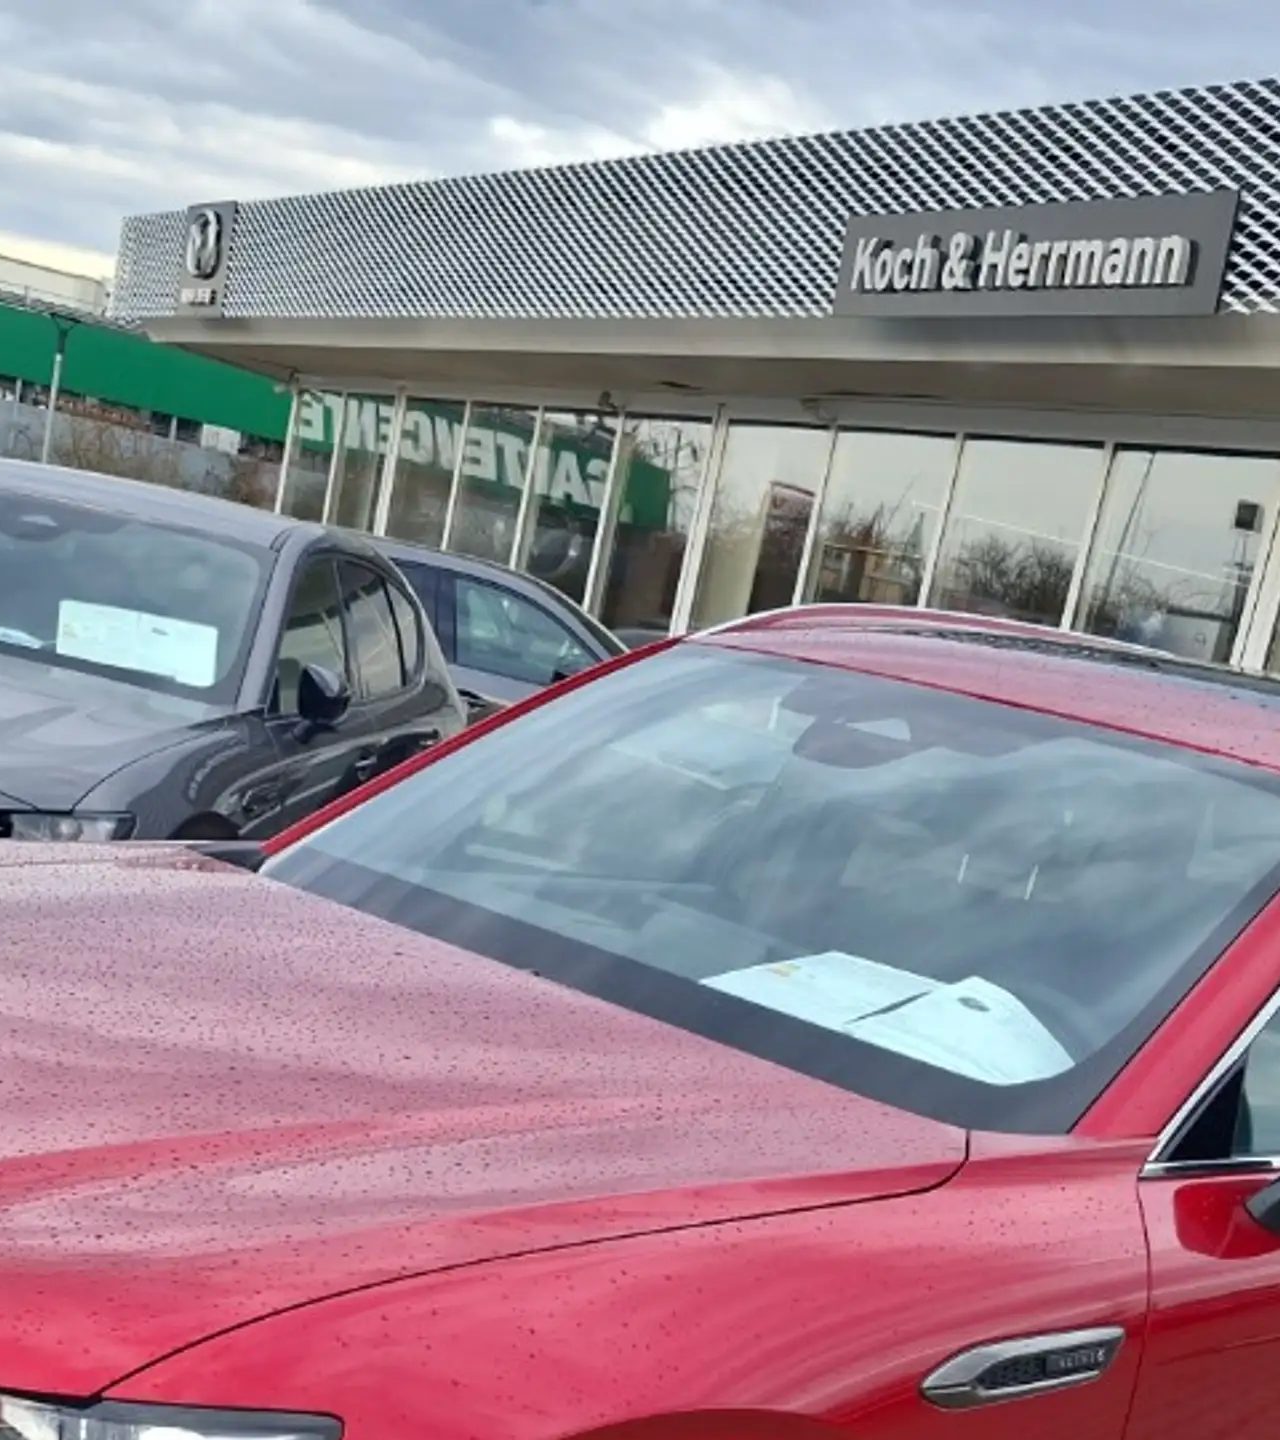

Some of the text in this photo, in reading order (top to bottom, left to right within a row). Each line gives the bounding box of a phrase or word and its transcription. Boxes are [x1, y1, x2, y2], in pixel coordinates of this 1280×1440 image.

[851, 229, 1191, 291] Koch & Herrmann
